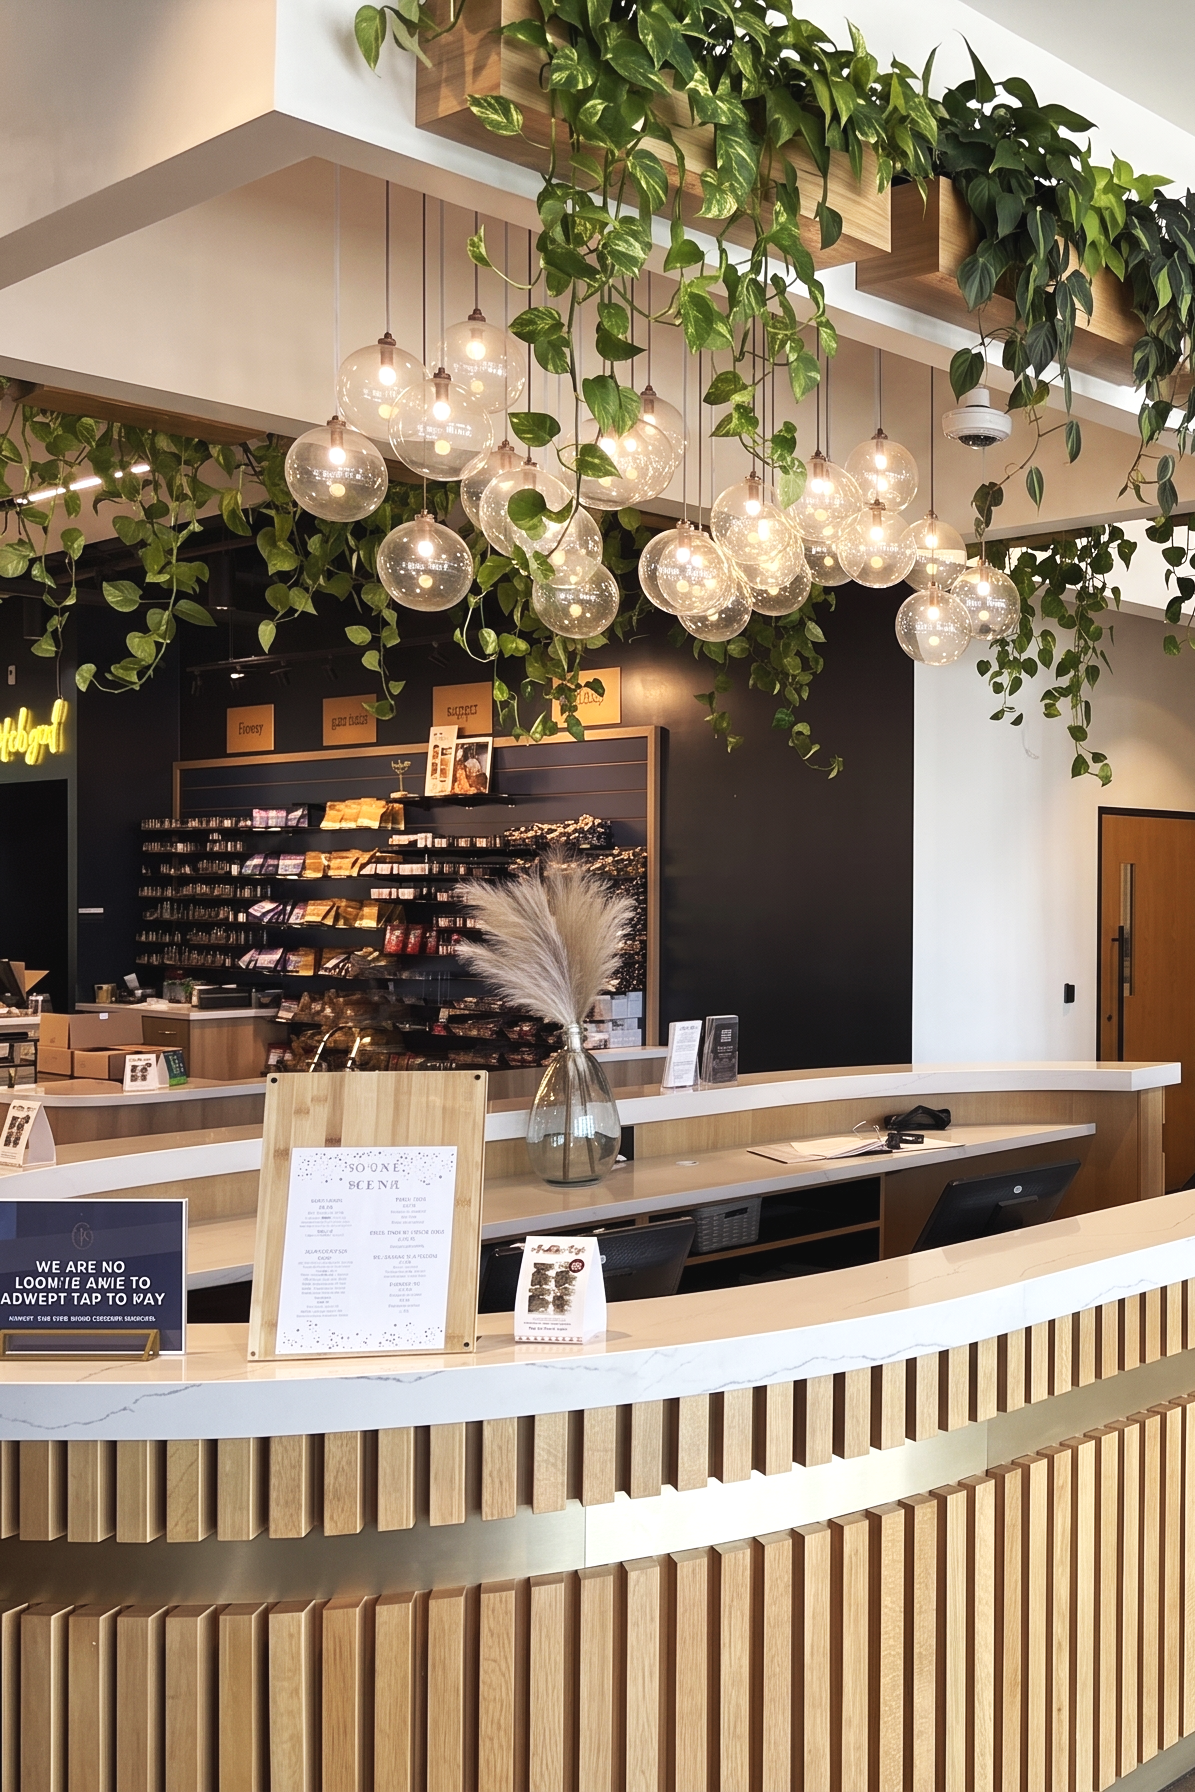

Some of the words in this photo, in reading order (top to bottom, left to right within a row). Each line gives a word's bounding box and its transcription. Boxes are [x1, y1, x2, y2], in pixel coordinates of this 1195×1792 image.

[36, 1260, 61, 1273] WE
[65, 1260, 97, 1273] ARE
[102, 1260, 126, 1273] NO
[130, 1276, 151, 1290] TO
[0, 1292, 67, 1306] ADWEPT
[71, 1292, 102, 1306] TAP
[106, 1292, 128, 1306] TO
